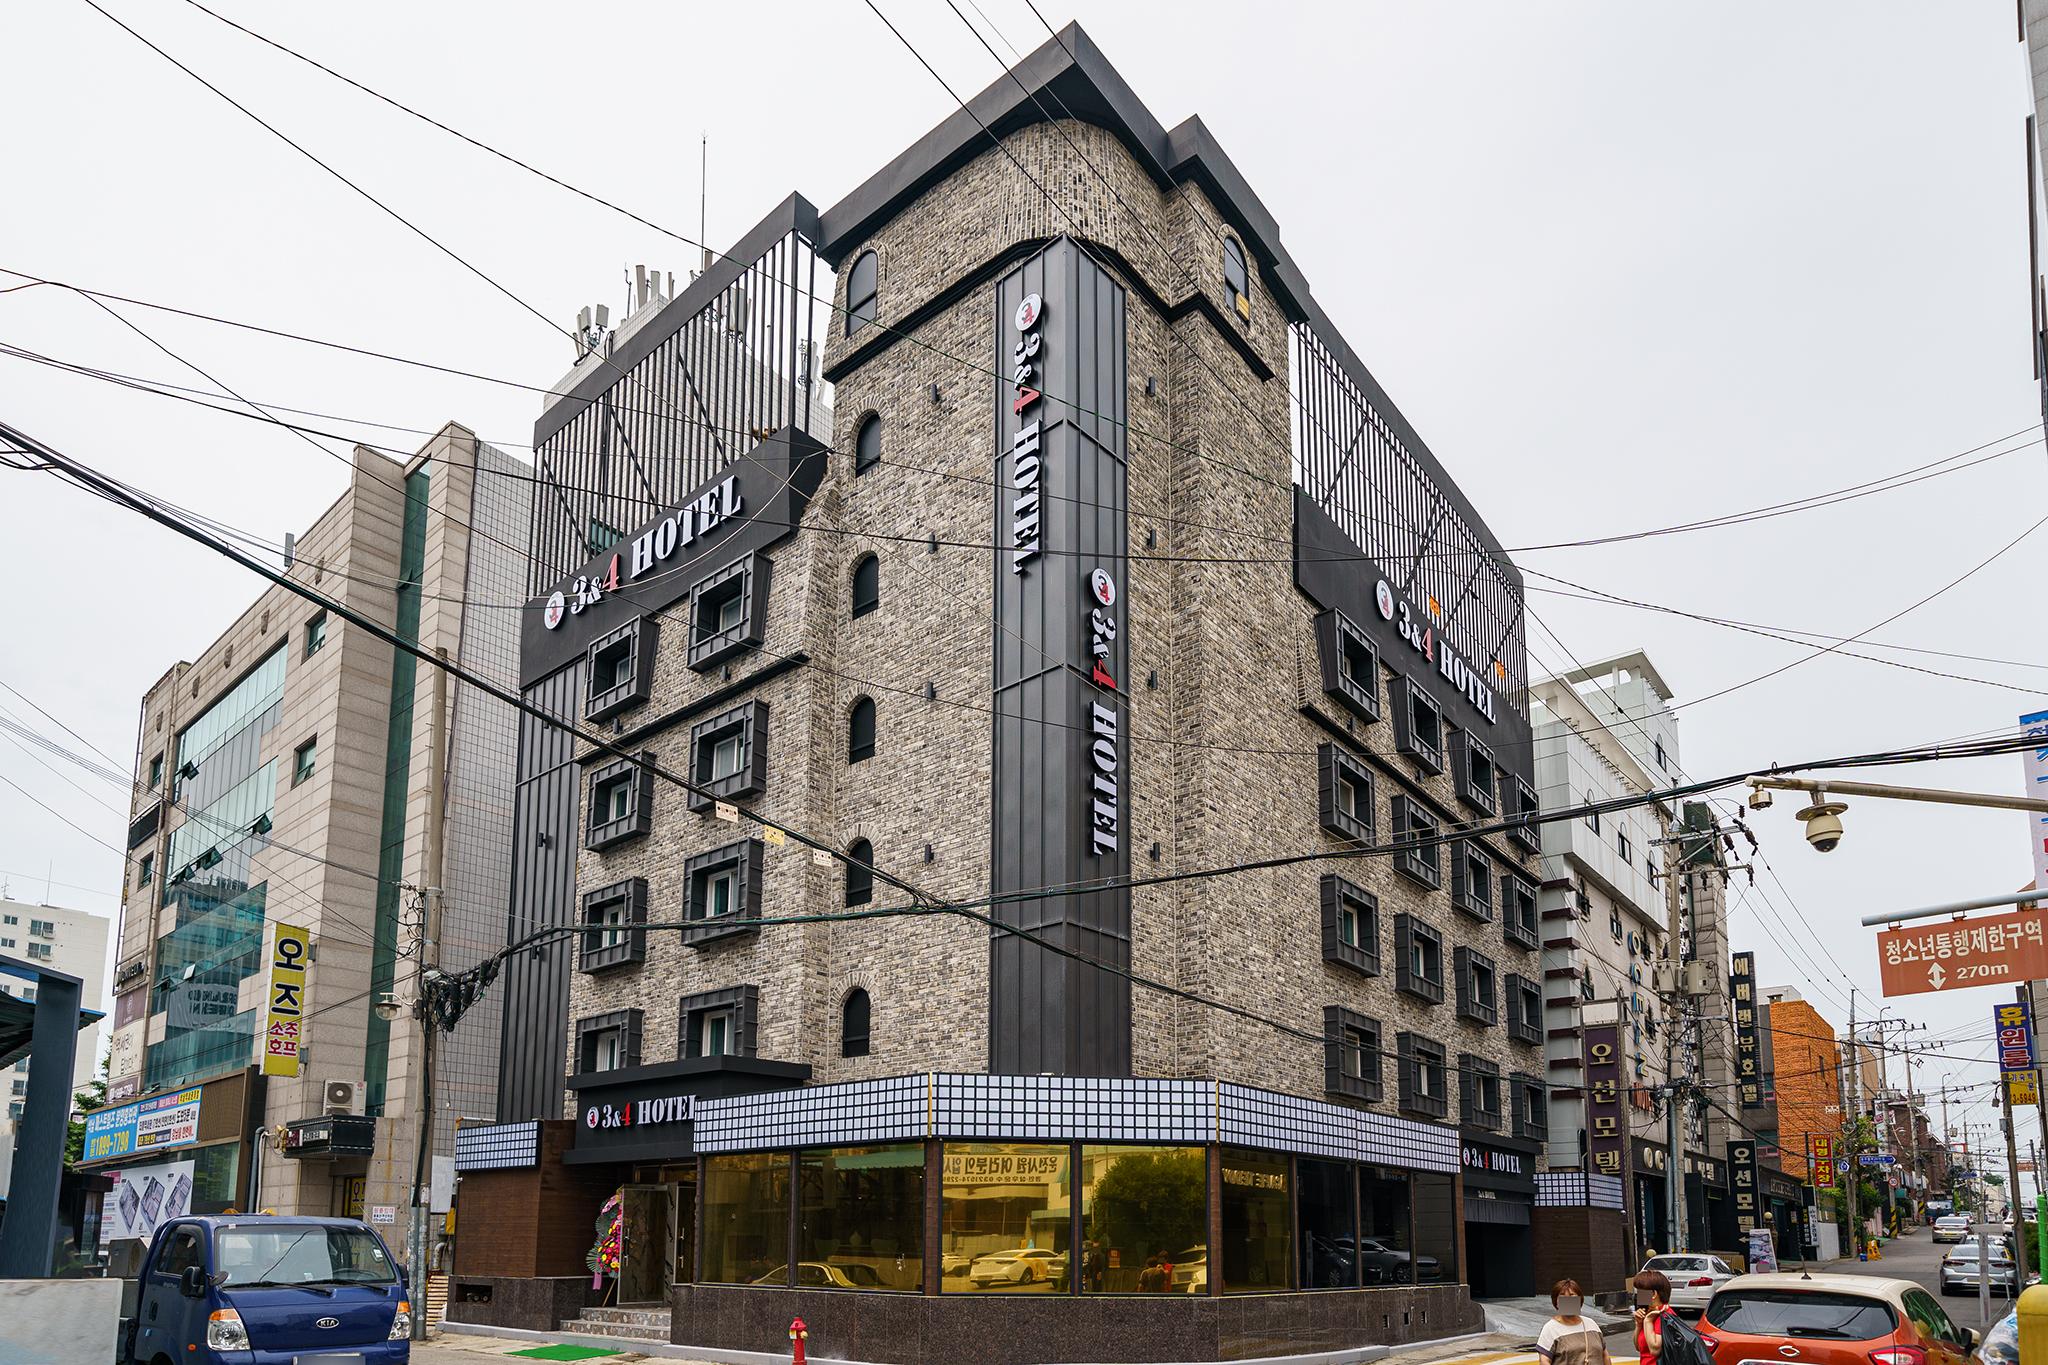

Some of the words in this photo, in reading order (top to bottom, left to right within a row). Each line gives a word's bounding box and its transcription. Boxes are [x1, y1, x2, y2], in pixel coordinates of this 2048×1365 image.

[1014, 332, 1040, 416] 3&4
[1013, 418, 1040, 575] HOTEL
[570, 552, 621, 615] 3&4
[630, 475, 743, 579] HOTEL
[1092, 608, 1117, 690] 3&4
[1399, 601, 1434, 663] 3&4
[1439, 640, 1496, 725] HOTEL
[1093, 701, 1118, 856] HOTEL
[271, 938, 305, 1016] 오즈
[1885, 918, 2044, 966] 청소년통행제한구역
[1956, 963, 2009, 980] 270m
[268, 1038, 297, 1057] 호프
[269, 1021, 298, 1038] 소주
[1998, 1007, 2032, 1069] 휴원룸
[601, 1103, 631, 1129] 3&4
[637, 1094, 697, 1125] HOTEL
[1589, 1042, 1621, 1175] 오션모텔
[2010, 1093, 2037, 1104] 3-5949
[1471, 1147, 1489, 1169] 3&4
[1491, 1151, 1522, 1174] HOTEL
[1733, 1147, 1755, 1233] 오션모텔
[320, 1319, 336, 1327] KIA
